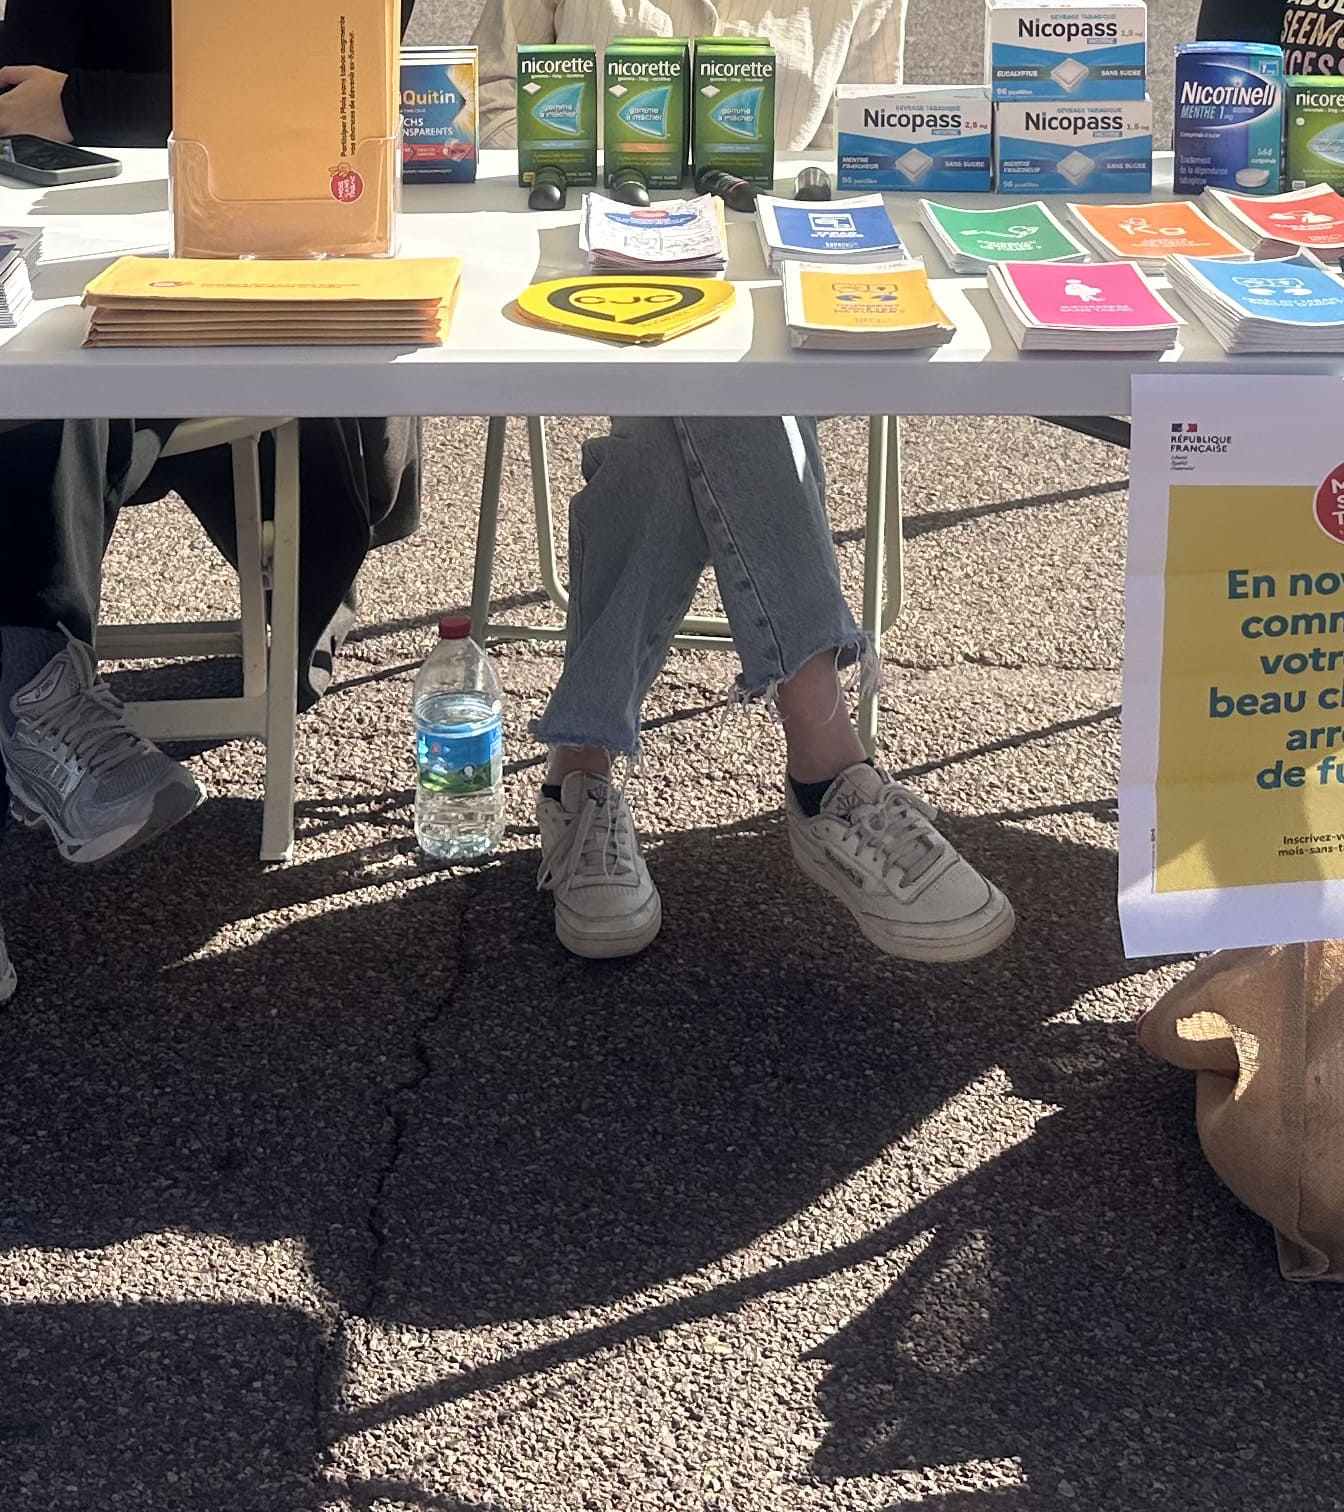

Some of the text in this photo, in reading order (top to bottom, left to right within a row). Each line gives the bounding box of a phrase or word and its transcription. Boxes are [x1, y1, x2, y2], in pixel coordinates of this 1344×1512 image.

[1018, 18, 1117, 42] Nicopass
[521, 57, 594, 74] nicorette
[608, 59, 681, 77] nicorette
[700, 60, 773, 77] nicorette
[399, 90, 455, 105] Quitin
[864, 108, 962, 132] Nicopass
[1180, 105, 1216, 119] MENTHE
[1025, 111, 1123, 135] Nicopass
[403, 127, 453, 137] NSPARENTS
[1170, 434, 1232, 444] RÉPUBLIQUE
[1170, 444, 1228, 453] FRANÇAISE
[1228, 569, 1276, 599] En
[1210, 687, 1306, 719] beau
[1256, 760, 1306, 790] de
